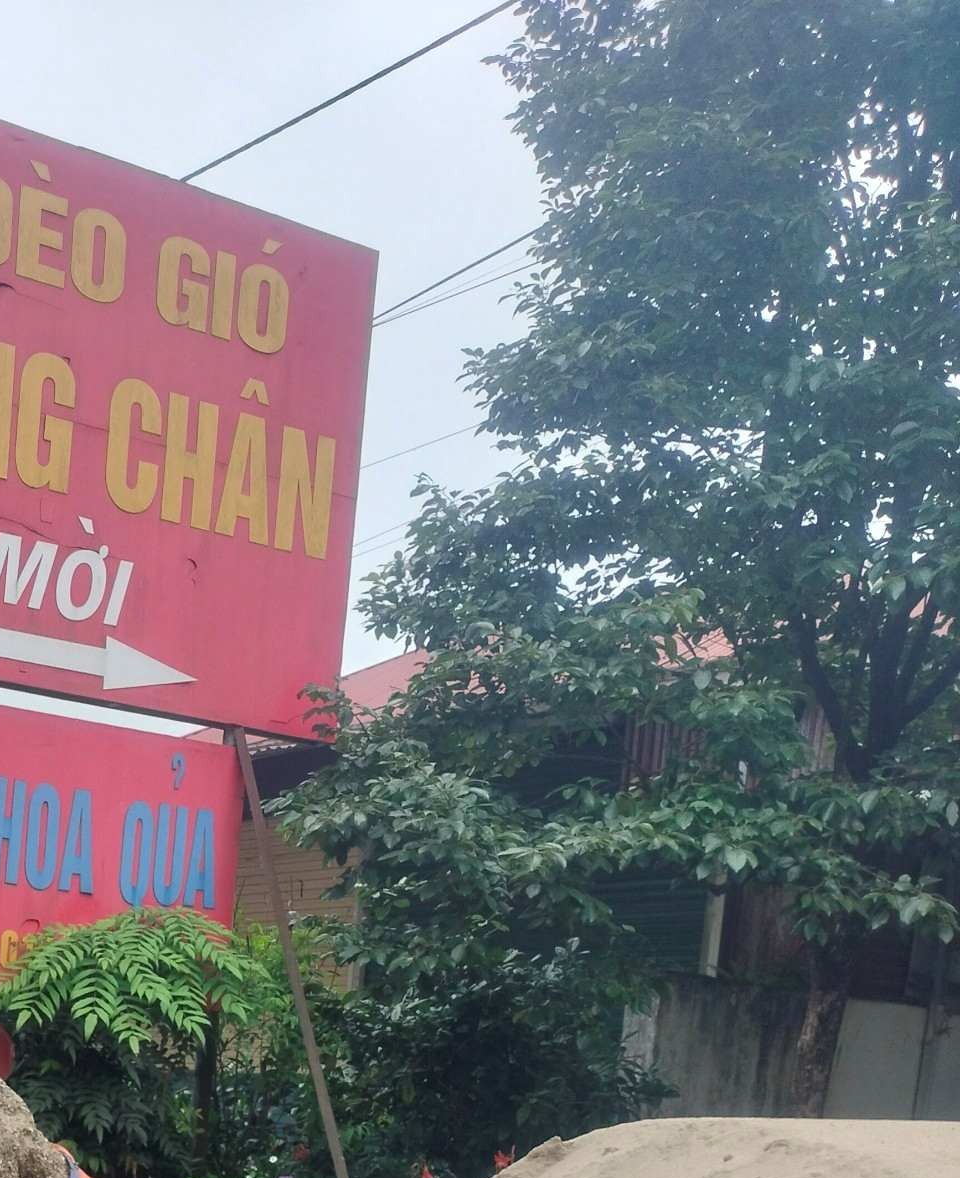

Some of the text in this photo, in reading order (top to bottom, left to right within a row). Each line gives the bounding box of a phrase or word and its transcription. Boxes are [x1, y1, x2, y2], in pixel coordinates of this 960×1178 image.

[156, 236, 289, 354] GIÓ
[105, 377, 336, 560] CHÂN
[119, 752, 215, 910] QUẢ
